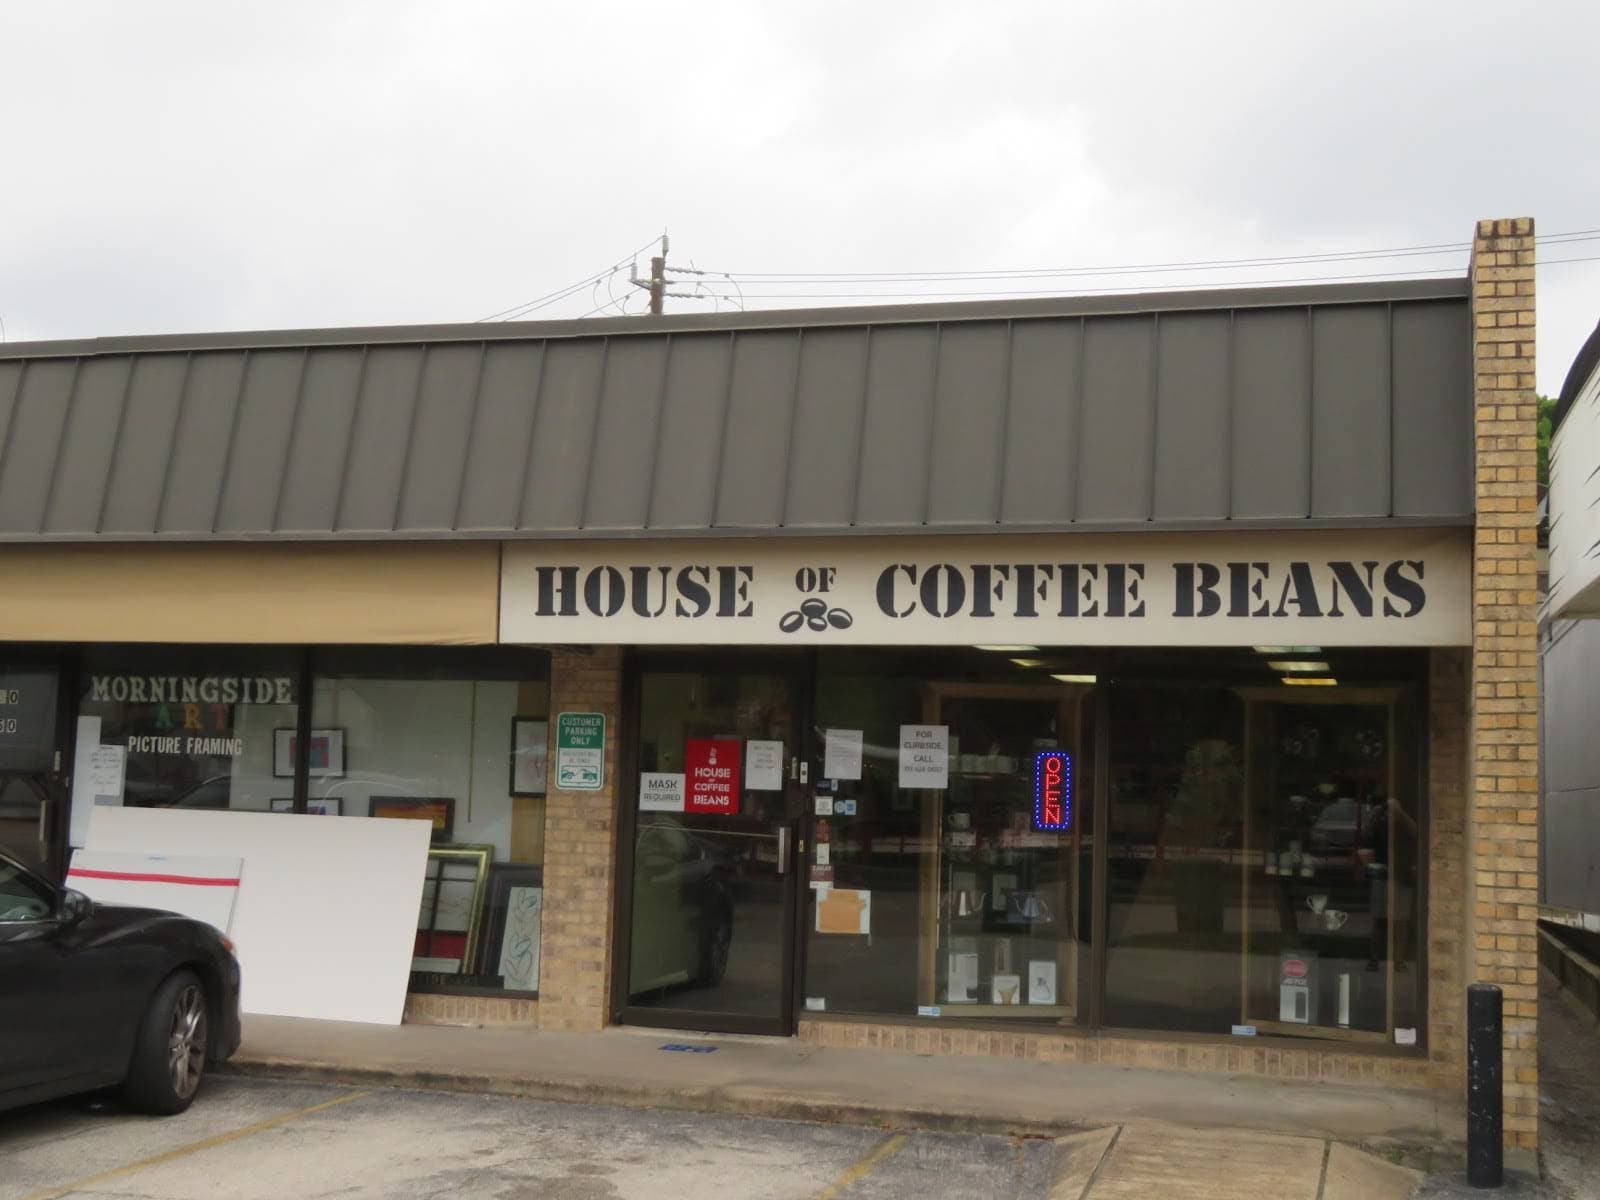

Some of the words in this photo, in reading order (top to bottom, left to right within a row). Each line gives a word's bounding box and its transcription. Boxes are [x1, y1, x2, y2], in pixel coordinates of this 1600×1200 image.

[534, 565, 754, 618] HOUSE
[794, 567, 837, 593] OF
[875, 563, 1145, 618] COFFEE
[1171, 560, 1426, 618] BEANS
[91, 676, 293, 705] MORNINGSIDE
[155, 704, 230, 730] ART
[561, 717, 601, 727] CUSTOMER
[565, 726, 598, 736] PARKING
[915, 730, 933, 738] FOR
[128, 735, 181, 754] PICTURE
[186, 736, 243, 756] FRAMING
[570, 736, 591, 745] ONLY
[913, 754, 934, 763] CALL
[694, 767, 731, 778] HOUSE
[648, 779, 678, 790] MASK
[694, 783, 730, 792] COFFEE
[1044, 756, 1061, 825] OPEN
[643, 792, 681, 803] REQUIRED
[693, 794, 730, 806] BEANS
